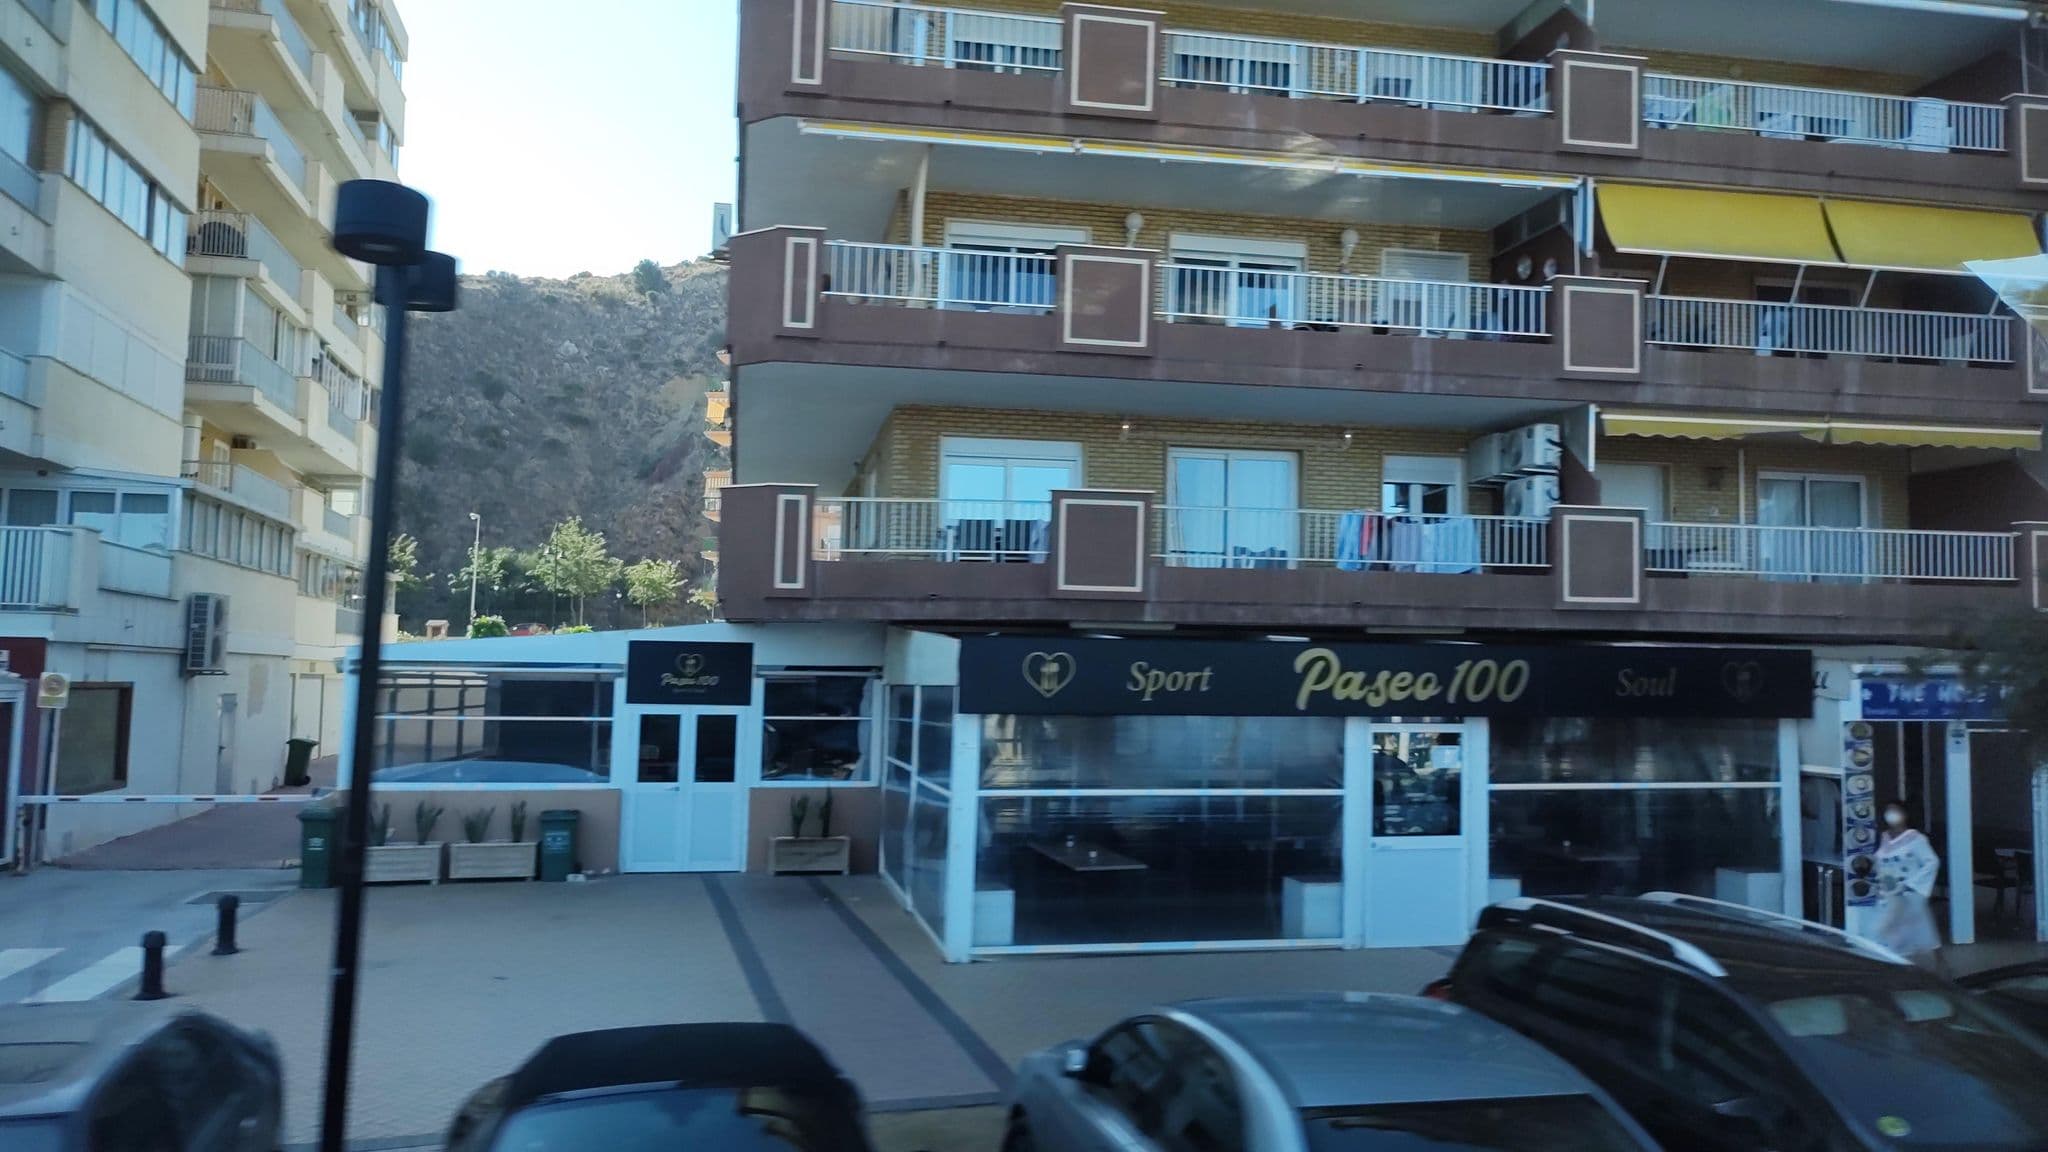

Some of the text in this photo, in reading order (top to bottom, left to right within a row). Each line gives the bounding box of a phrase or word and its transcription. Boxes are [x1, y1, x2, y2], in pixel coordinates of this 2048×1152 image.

[1126, 661, 1214, 701] Sport
[1294, 648, 1530, 711] Paseo 100
[1616, 667, 1677, 697] Soul
